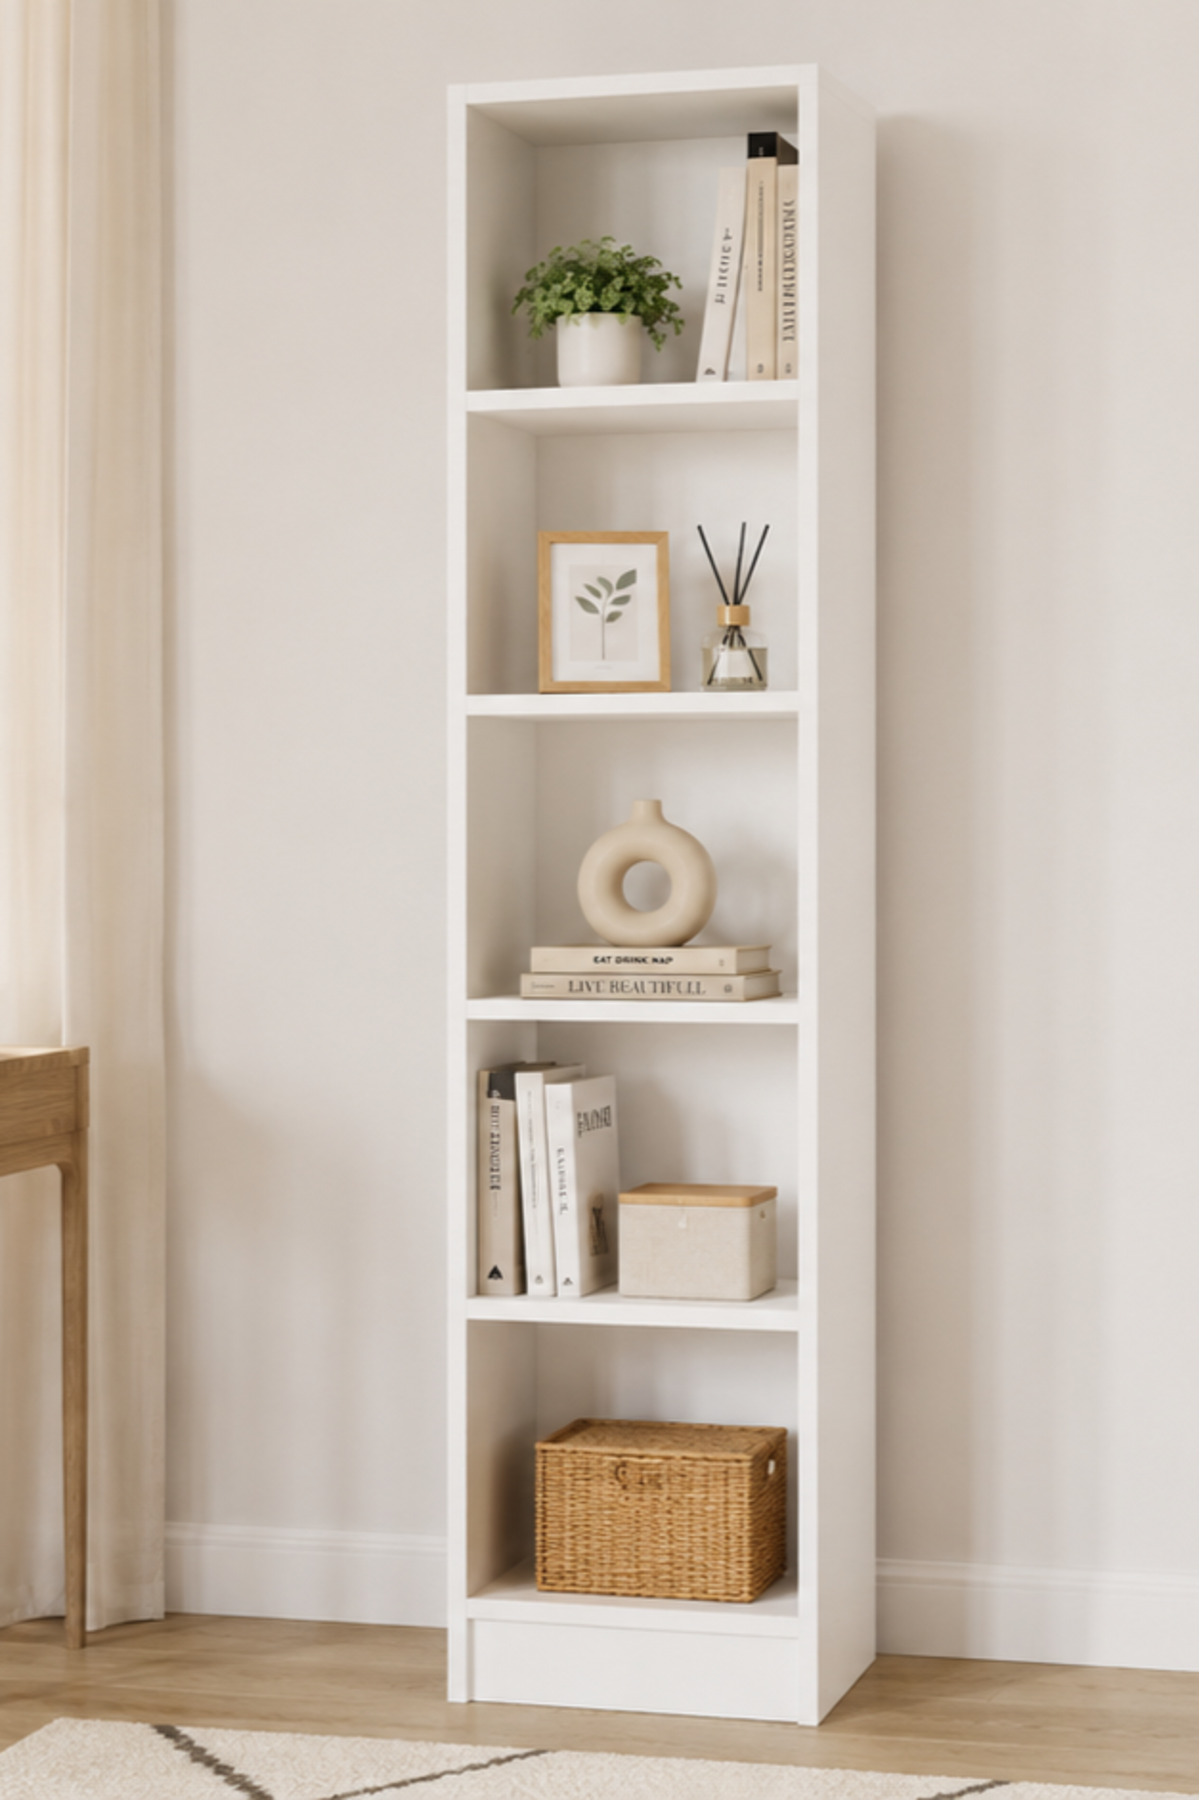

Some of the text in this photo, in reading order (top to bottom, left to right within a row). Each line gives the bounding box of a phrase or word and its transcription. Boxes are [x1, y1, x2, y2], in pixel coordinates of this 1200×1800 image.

[593, 955, 674, 965] EAT DRINK NAP
[568, 979, 605, 994] LIVE
